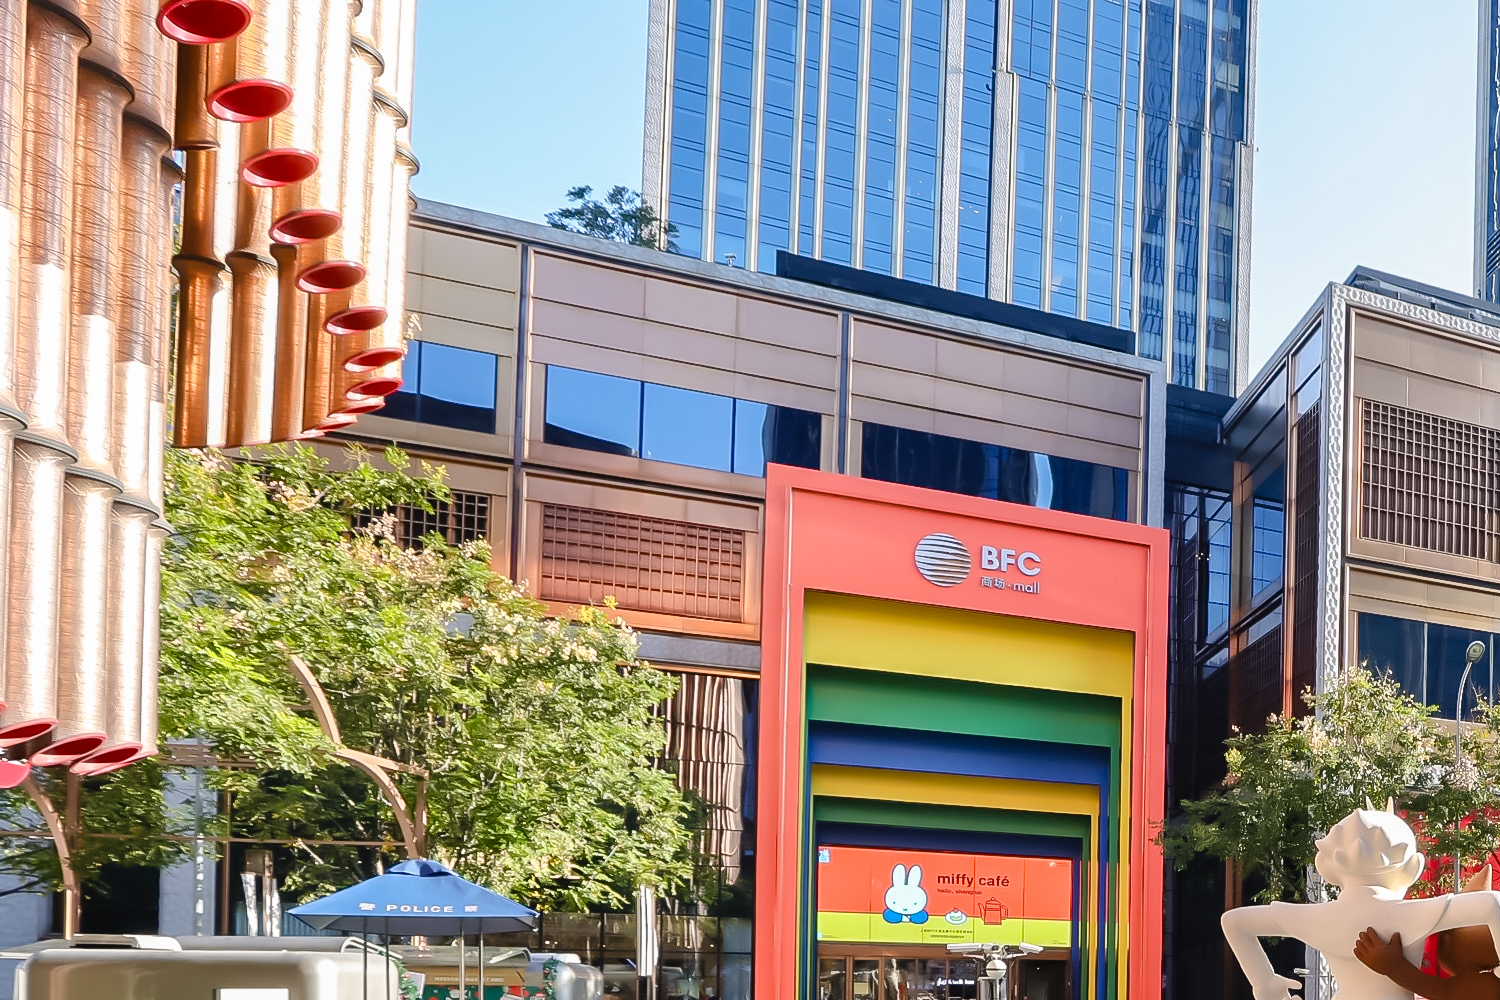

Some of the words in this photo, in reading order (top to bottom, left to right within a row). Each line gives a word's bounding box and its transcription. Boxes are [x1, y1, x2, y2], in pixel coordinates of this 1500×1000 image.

[981, 545, 1041, 576] BFC
[981, 576, 1005, 589] 商场
[1013, 581, 1040, 594] mall
[937, 873, 974, 887] miffy
[978, 875, 1000, 887] café
[386, 904, 454, 913] POLICE
